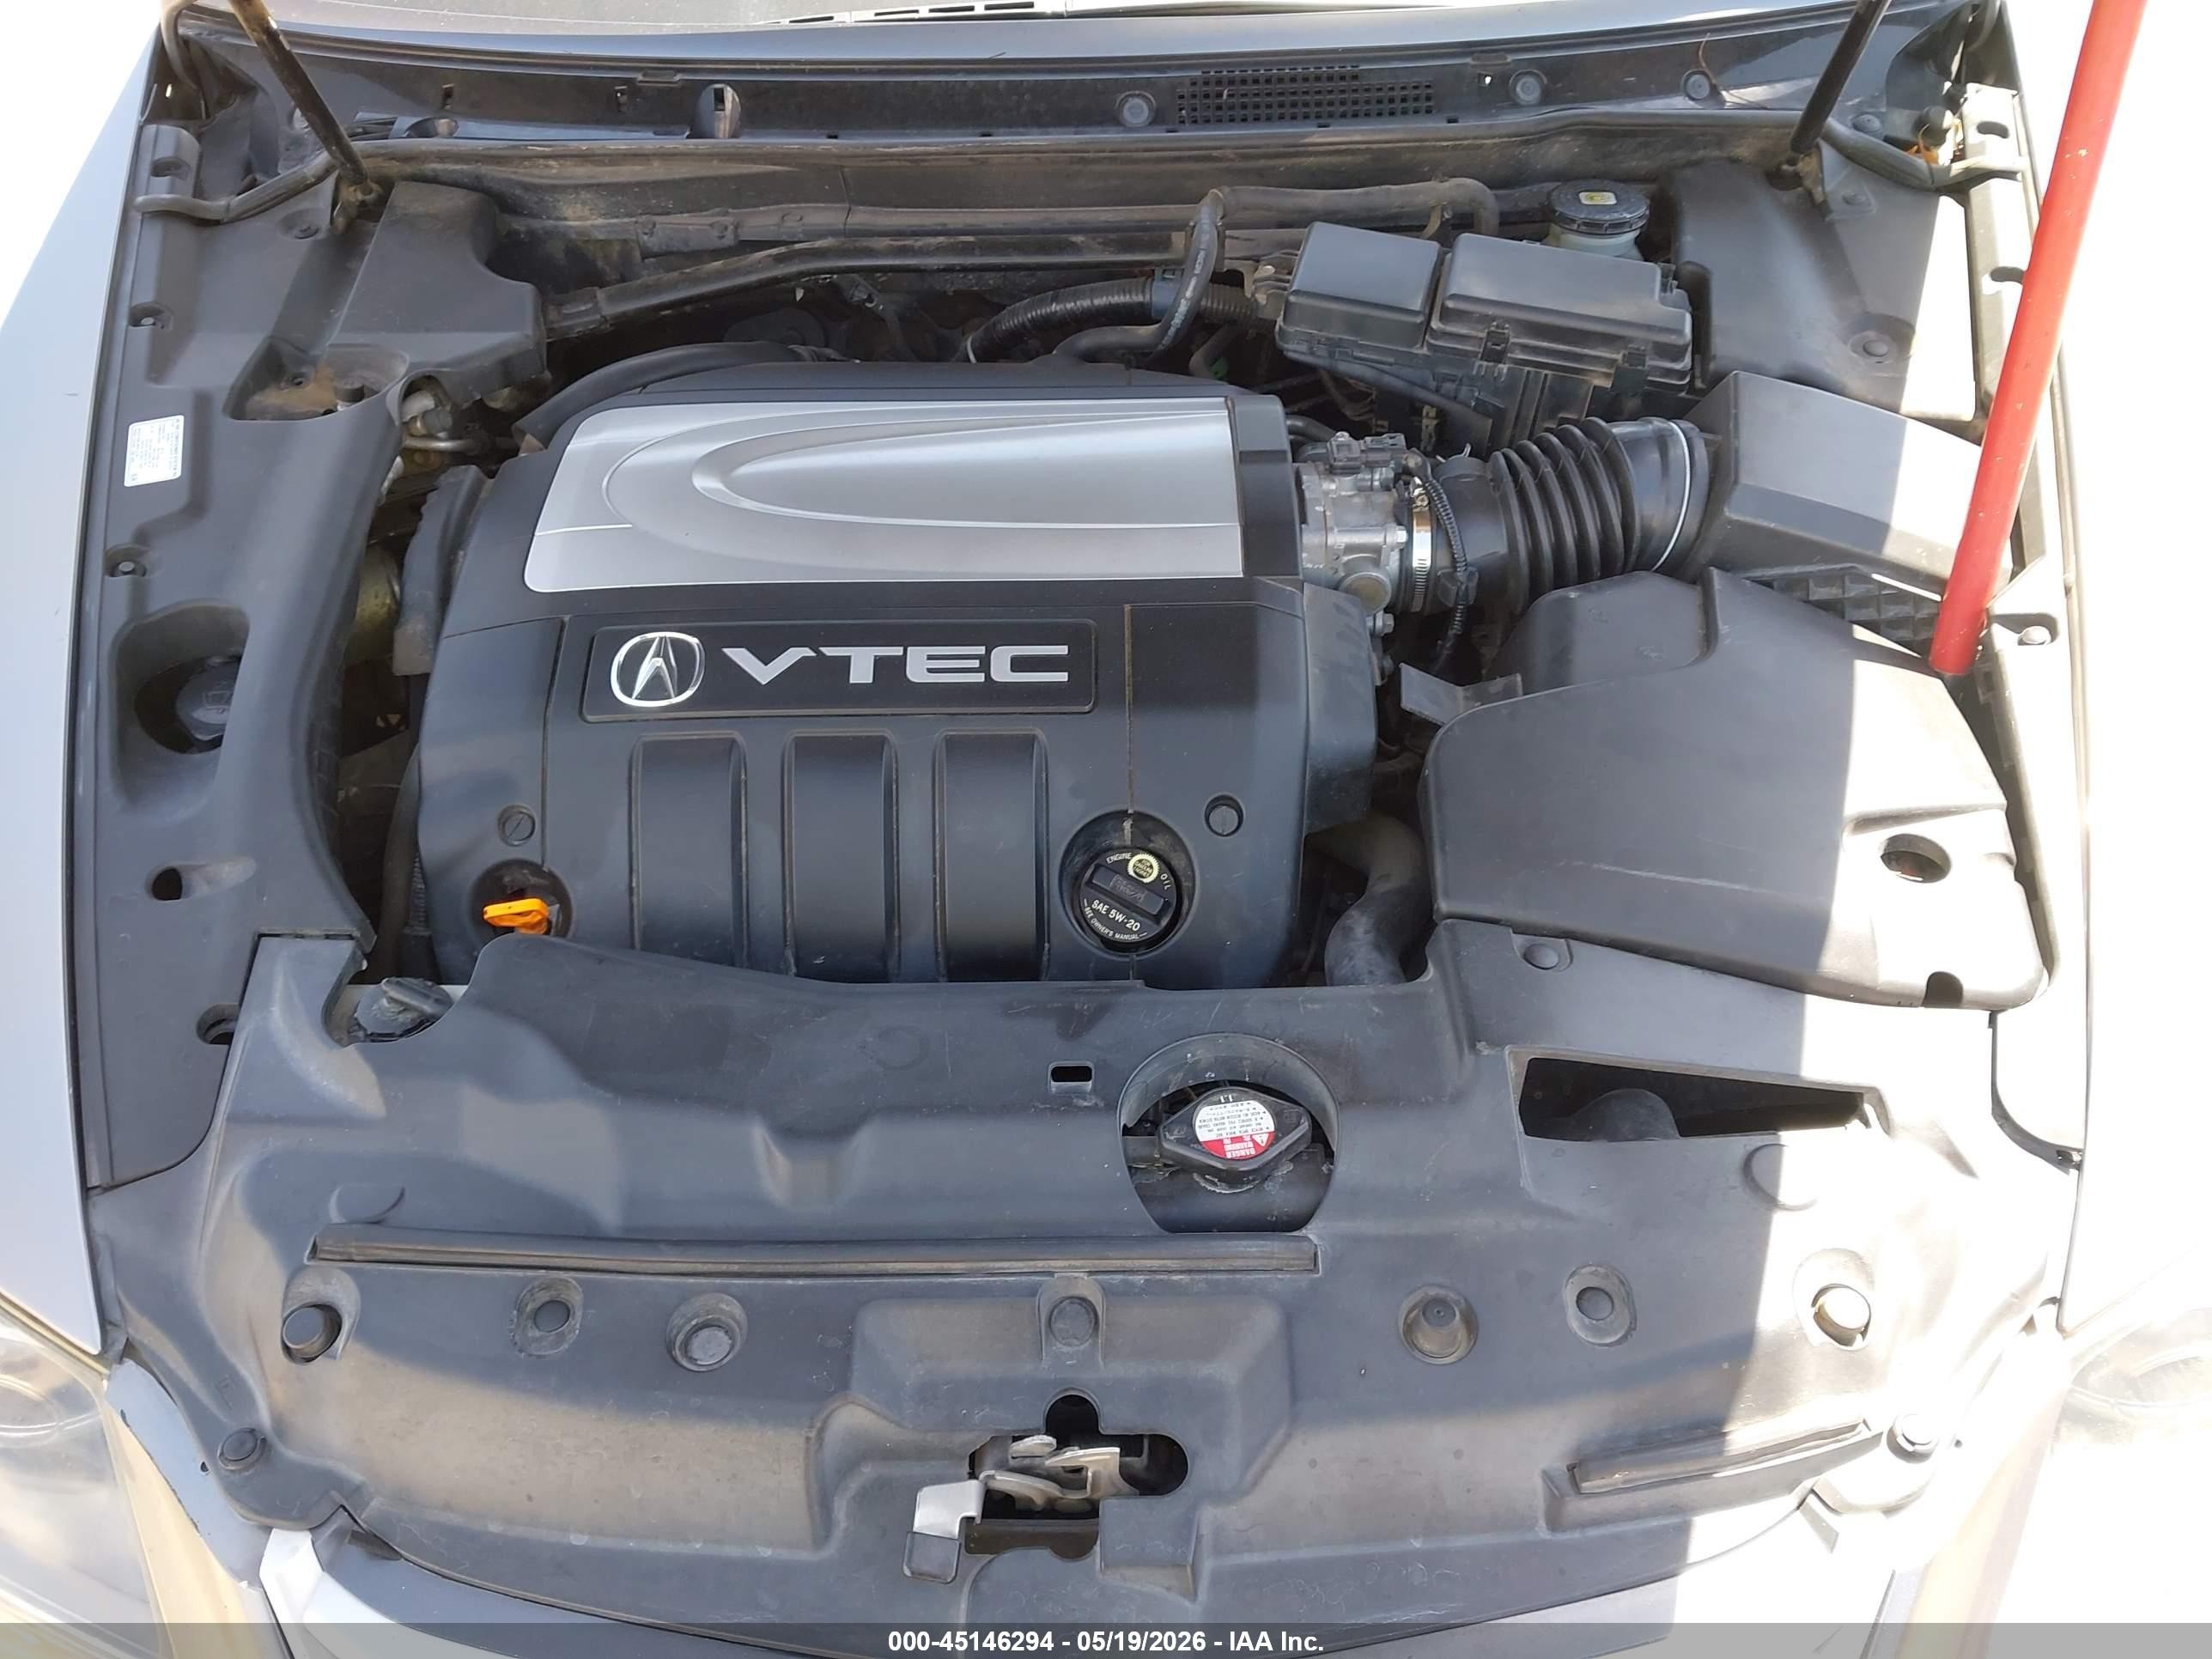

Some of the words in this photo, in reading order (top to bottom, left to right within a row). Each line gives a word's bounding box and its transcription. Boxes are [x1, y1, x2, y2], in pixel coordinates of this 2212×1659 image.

[721, 646, 1068, 685] VTEC
[1106, 853, 1133, 864] ENGINE
[1160, 873, 1171, 890] OIL
[1091, 899, 1110, 915] SAE
[1108, 908, 1140, 932] 5W-20
[1091, 918, 1114, 937] OWNER'S
